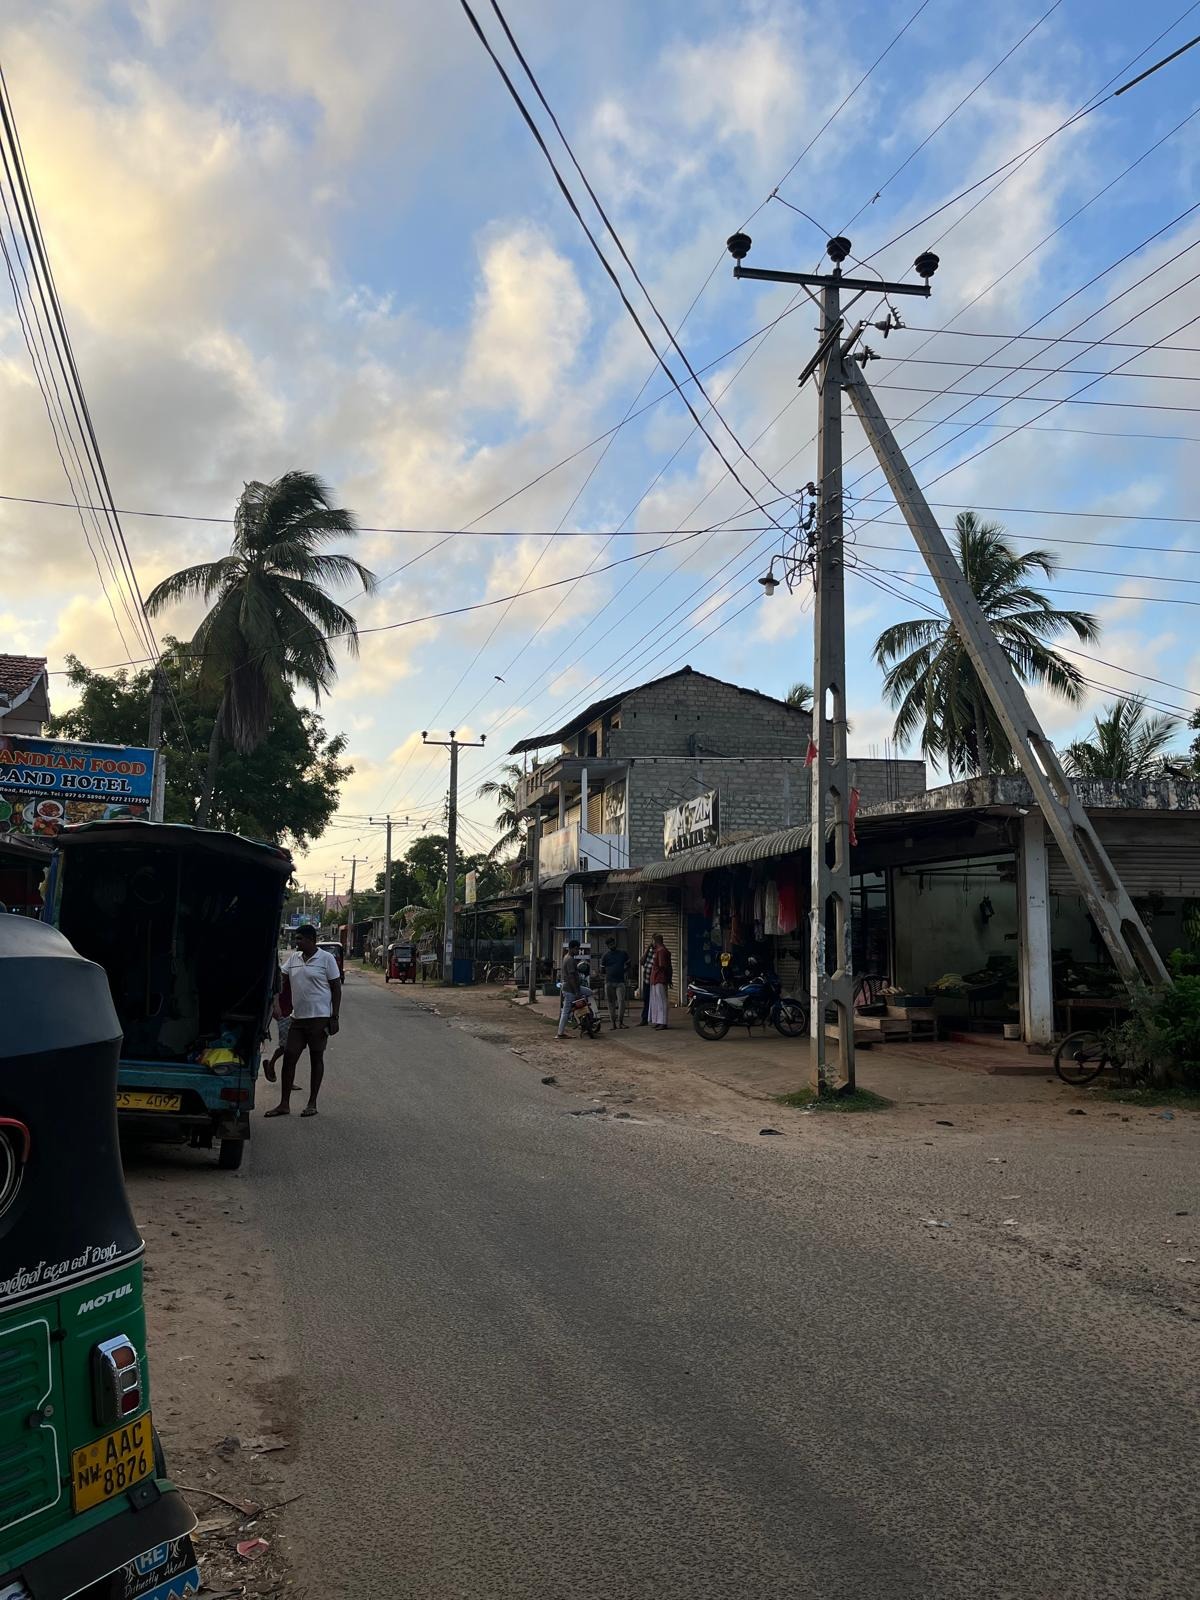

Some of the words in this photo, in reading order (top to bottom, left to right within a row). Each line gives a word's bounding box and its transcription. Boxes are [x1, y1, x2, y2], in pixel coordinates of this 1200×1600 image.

[61, 773, 132, 793] HOTEL
[90, 758, 146, 775] FOOD
[77, 1283, 133, 1316] MOTUL
[105, 1421, 144, 1464] AAC
[78, 1462, 100, 1489] NW
[103, 1449, 147, 1495] 8876
